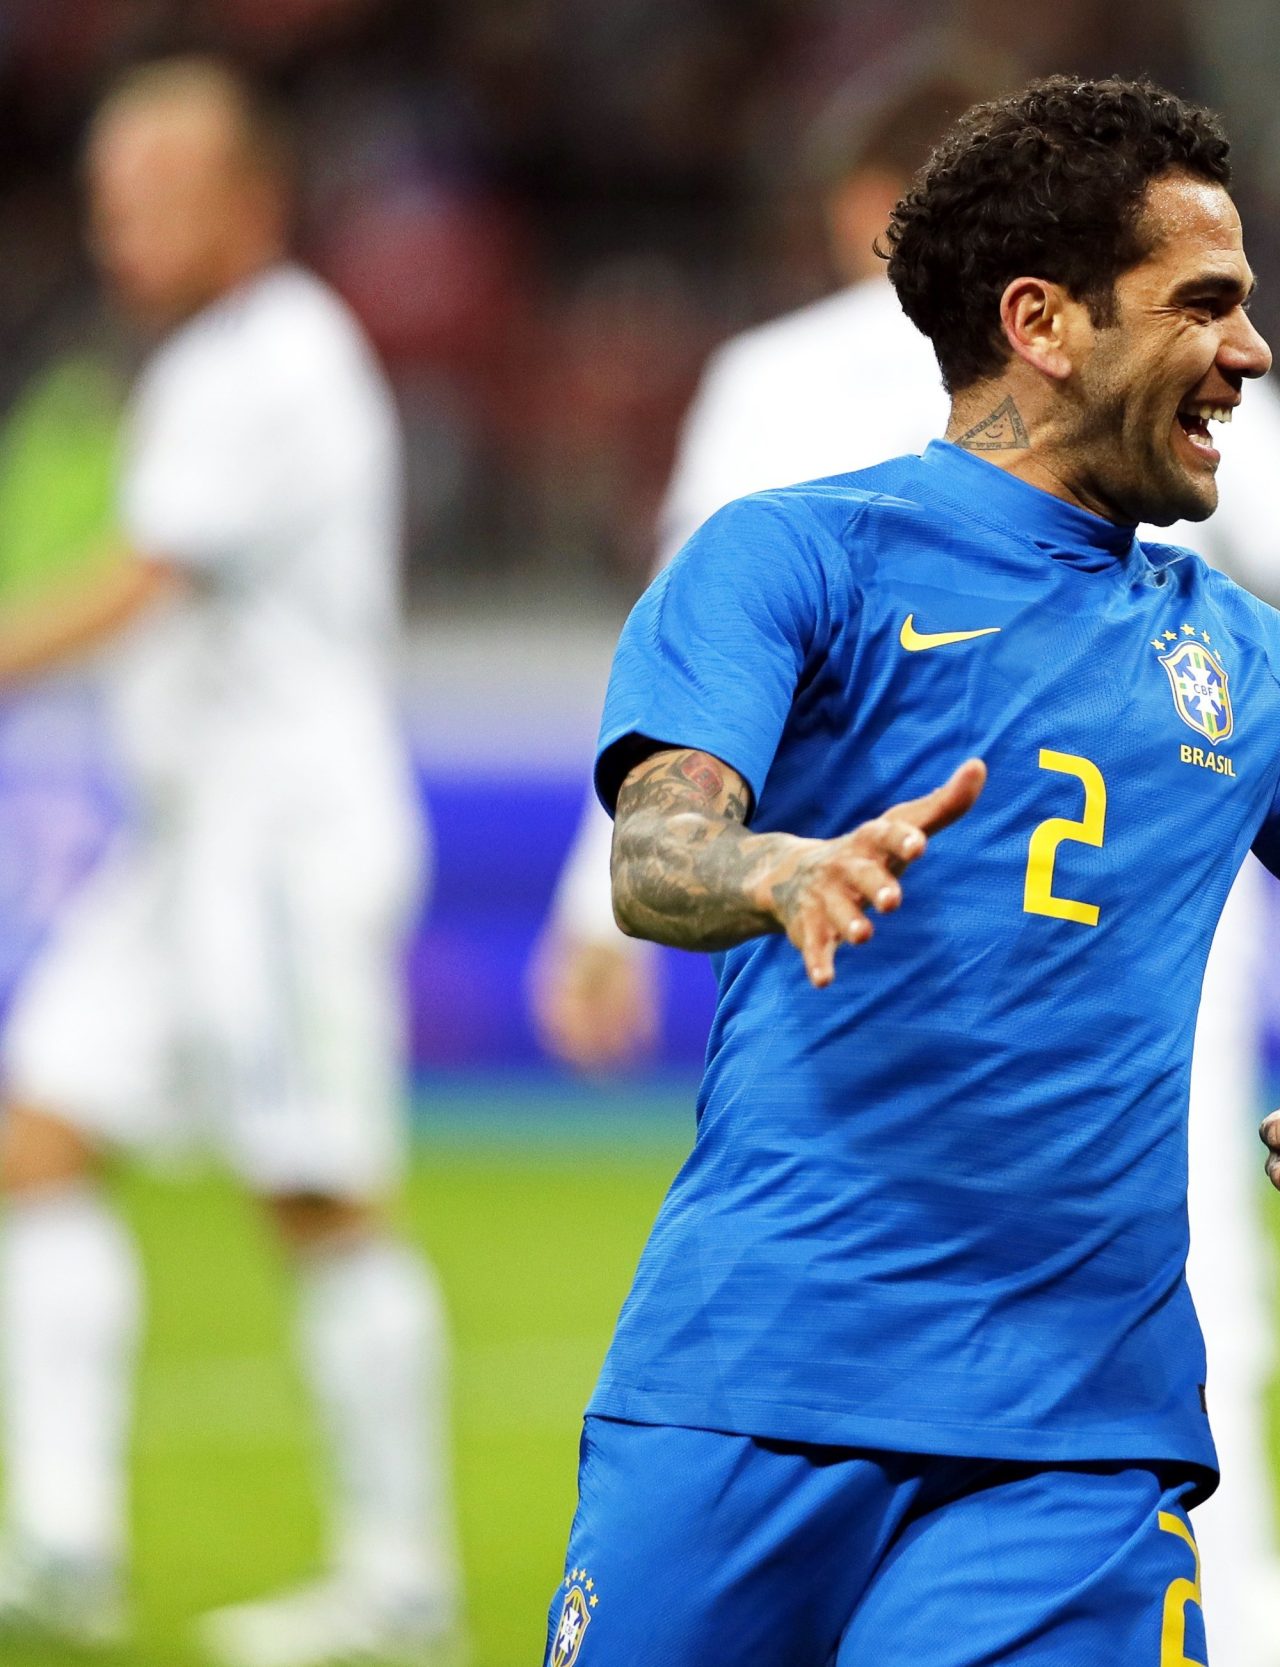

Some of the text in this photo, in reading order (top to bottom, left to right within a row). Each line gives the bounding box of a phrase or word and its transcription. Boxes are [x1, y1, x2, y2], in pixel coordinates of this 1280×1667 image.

[1193, 683, 1213, 696] CBF
[1180, 744, 1236, 777] BRASIL
[1023, 748, 1107, 927] 2
